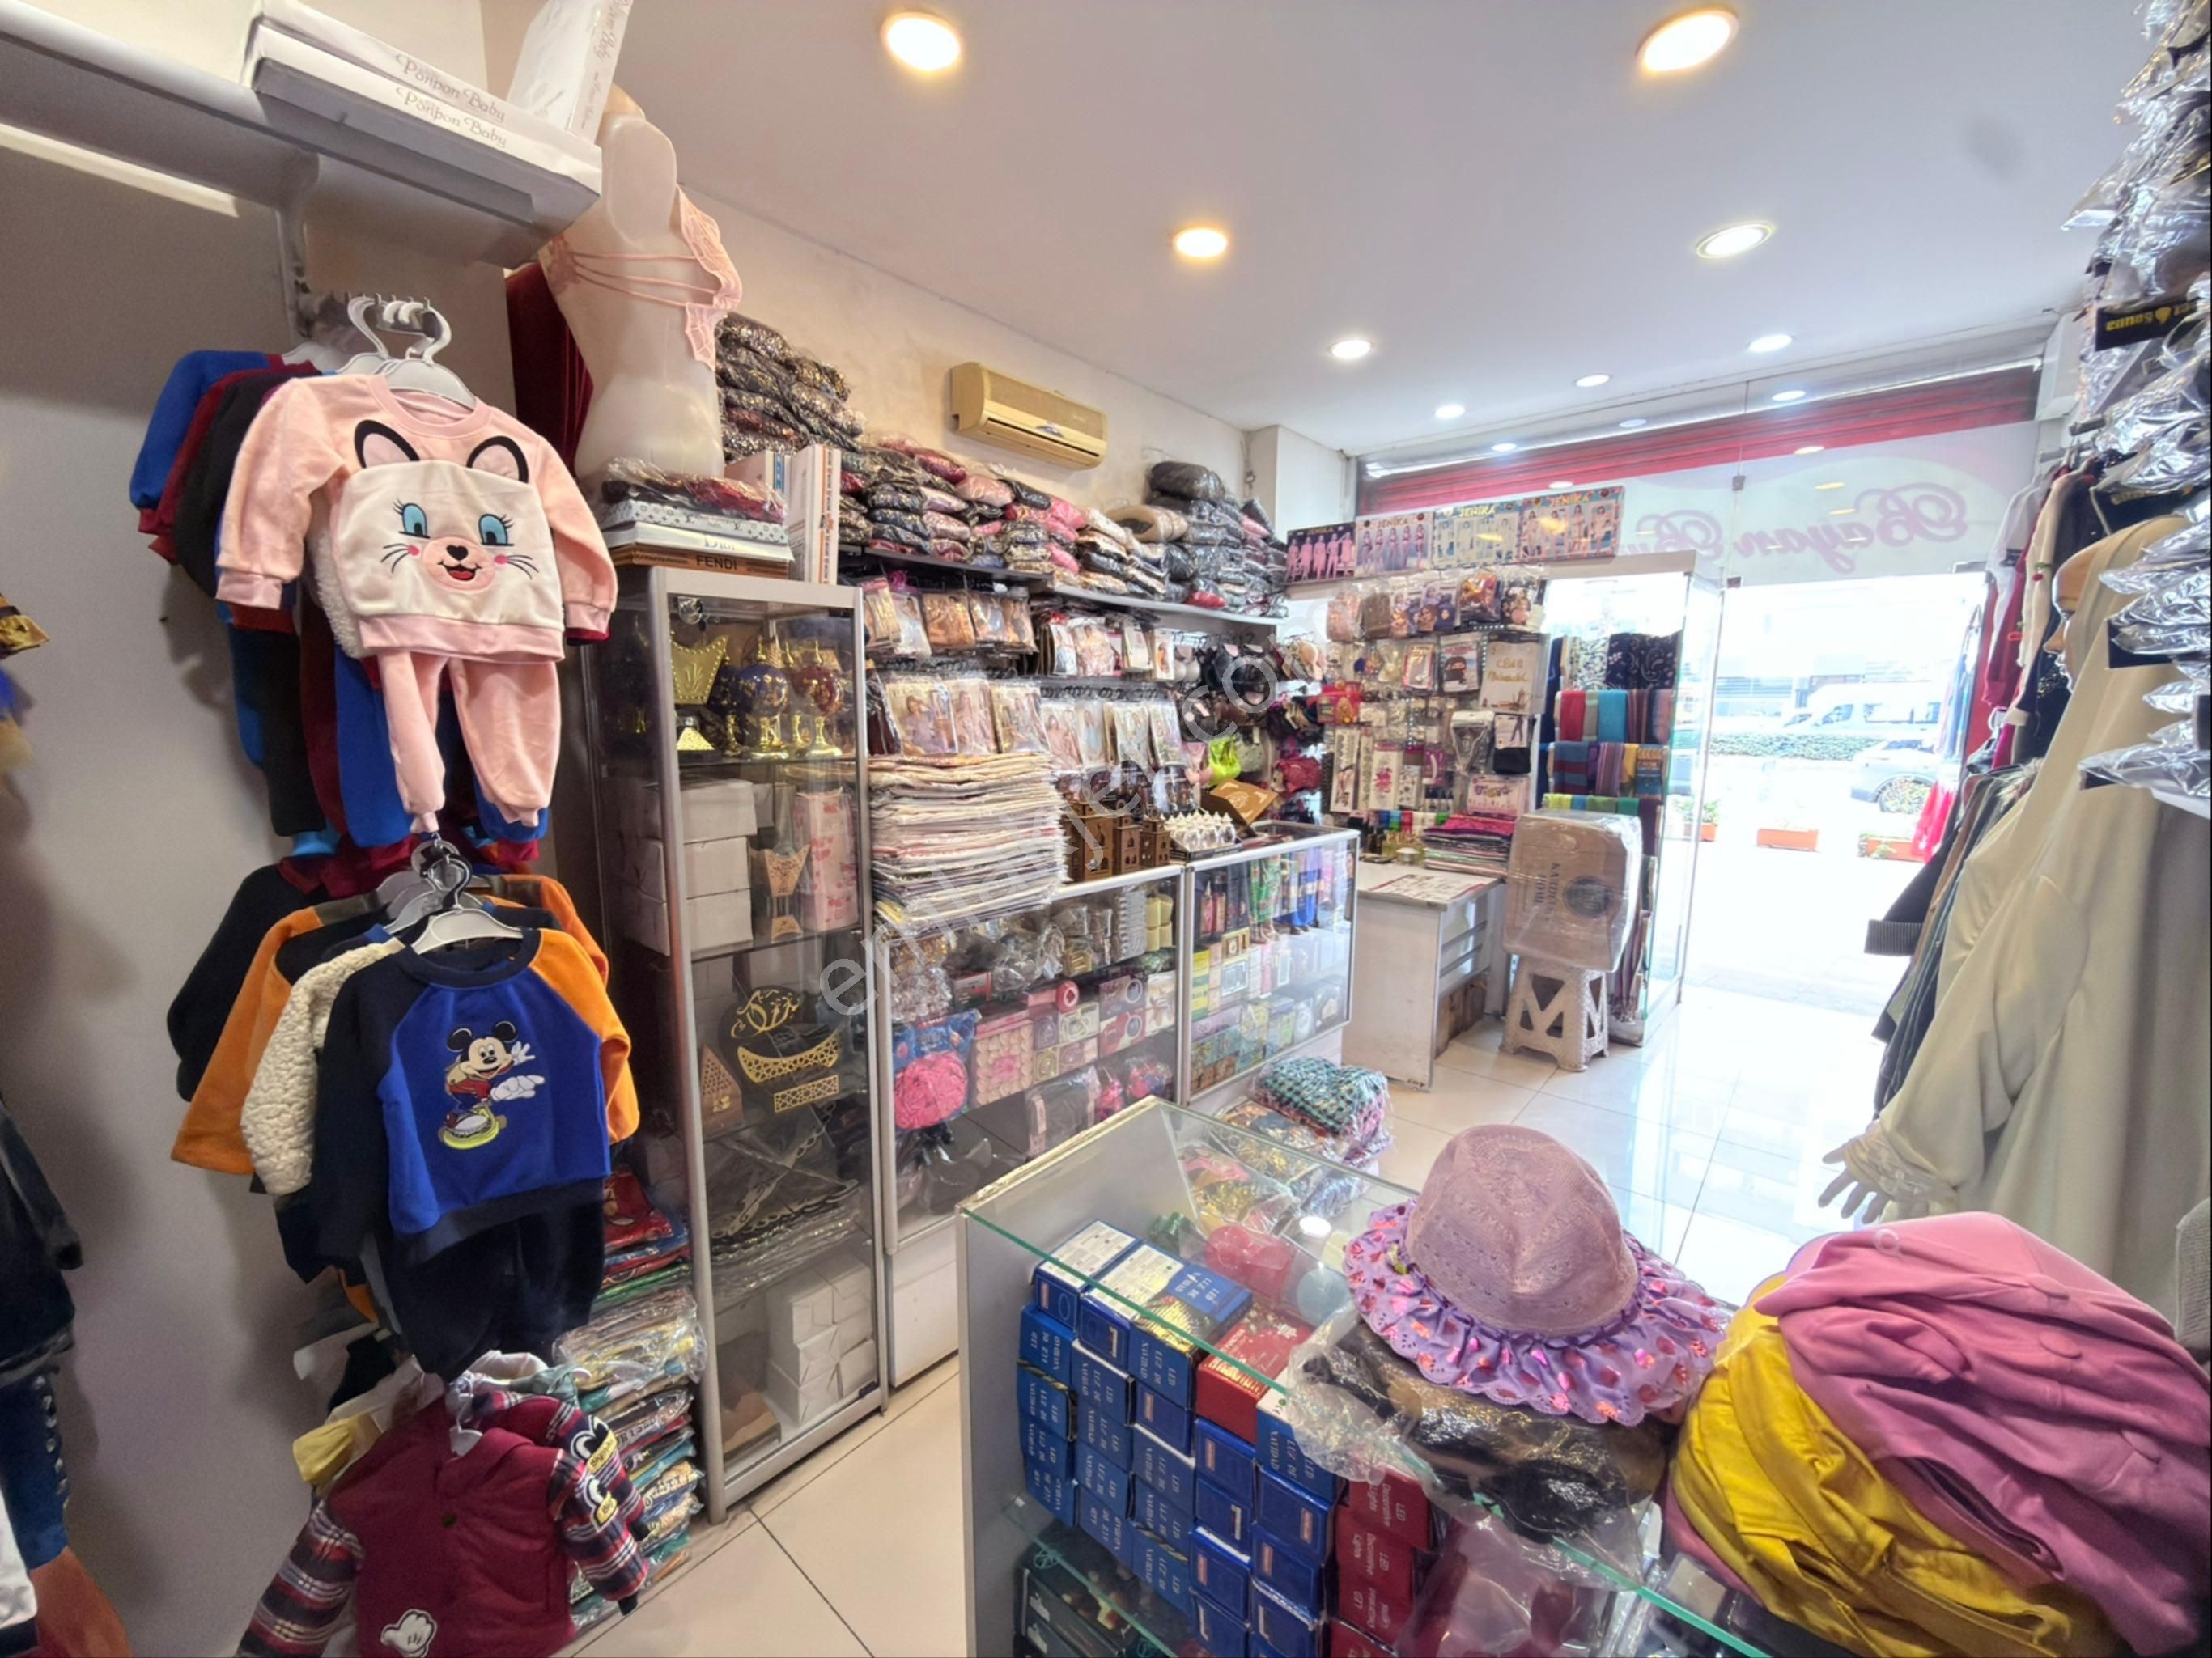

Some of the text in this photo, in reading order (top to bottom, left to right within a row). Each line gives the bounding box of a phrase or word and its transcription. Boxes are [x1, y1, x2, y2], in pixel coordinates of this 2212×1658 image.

[463, 88, 506, 124] Baby
[463, 117, 507, 149] Baby
[695, 554, 738, 571] FENDI
[1395, 1502, 1407, 1522] LED
[1379, 1552, 1390, 1572] LED
